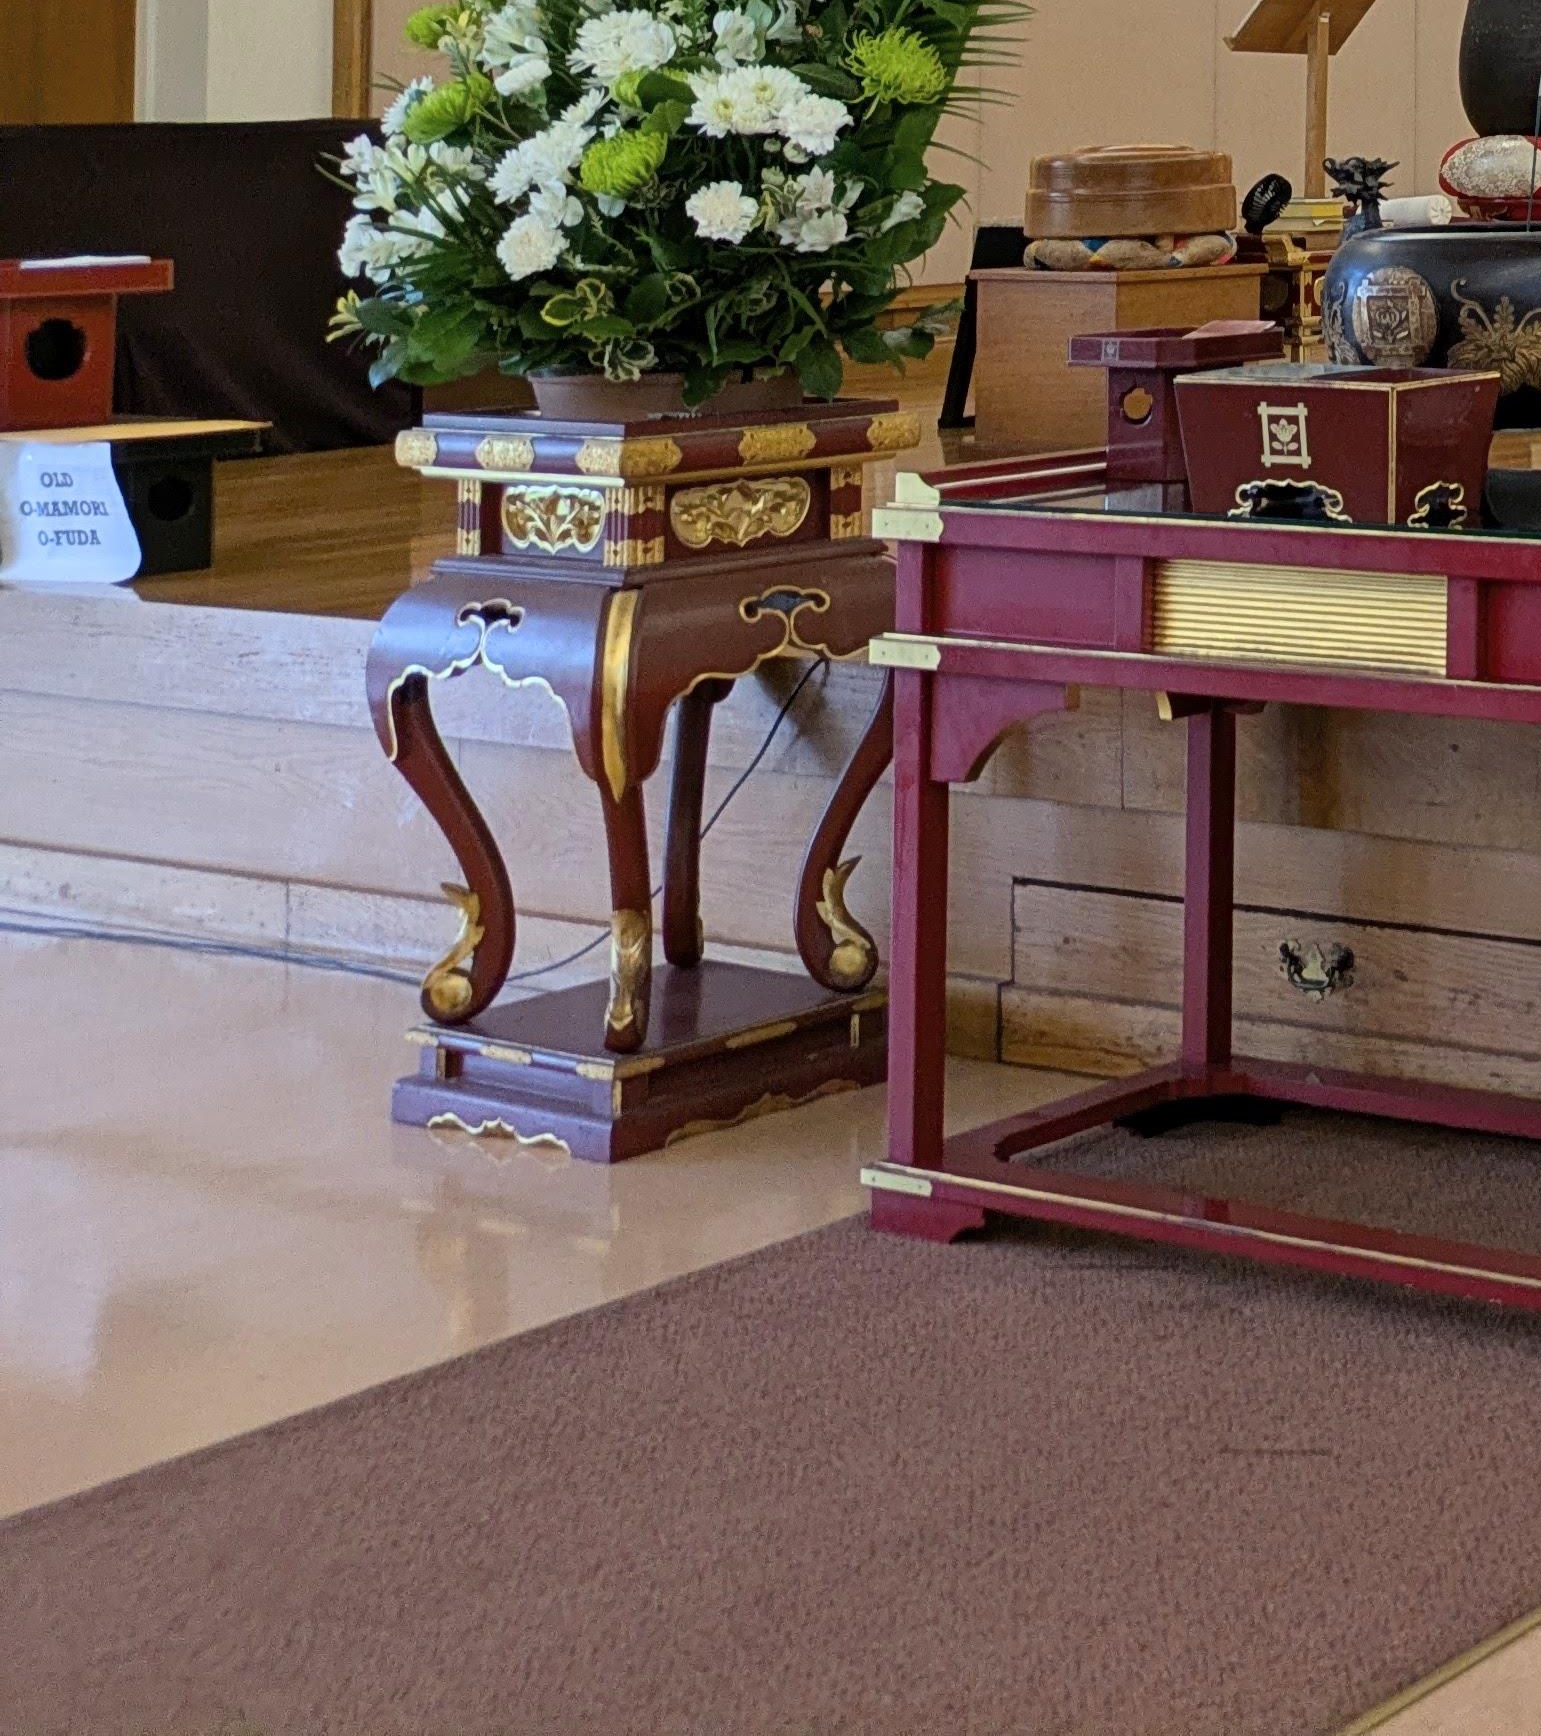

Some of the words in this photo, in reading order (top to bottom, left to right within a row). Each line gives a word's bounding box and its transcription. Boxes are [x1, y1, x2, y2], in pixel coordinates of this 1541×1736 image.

[40, 472, 74, 488] OLD
[19, 500, 109, 517] O-MAMORI
[37, 529, 102, 546] O-FUDA
